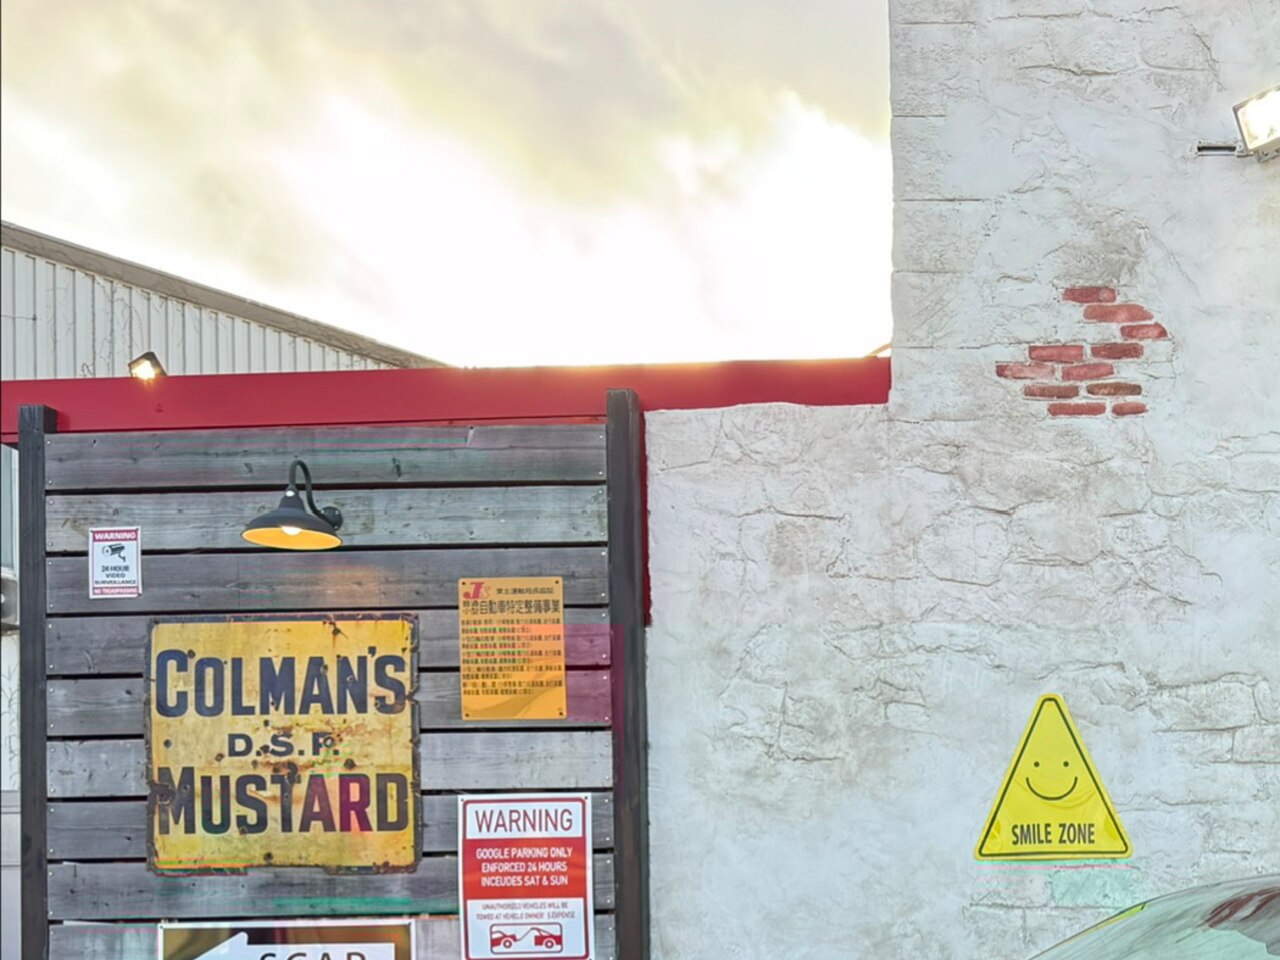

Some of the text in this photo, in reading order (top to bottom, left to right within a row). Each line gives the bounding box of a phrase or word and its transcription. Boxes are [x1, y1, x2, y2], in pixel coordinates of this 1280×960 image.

[94, 532, 137, 541] WARNING
[155, 645, 406, 718] COLMAN'S
[156, 766, 410, 835] MUSTARD
[474, 808, 573, 833] WARNING
[1011, 823, 1095, 845] SMILE ZONE
[476, 847, 573, 859] GOOGLE PARKING ONLY
[481, 862, 568, 874] ENFORCED 24 HOURS
[524, 876, 541, 886] SAT
[542, 876, 549, 886] &
[550, 875, 568, 885] SUN
